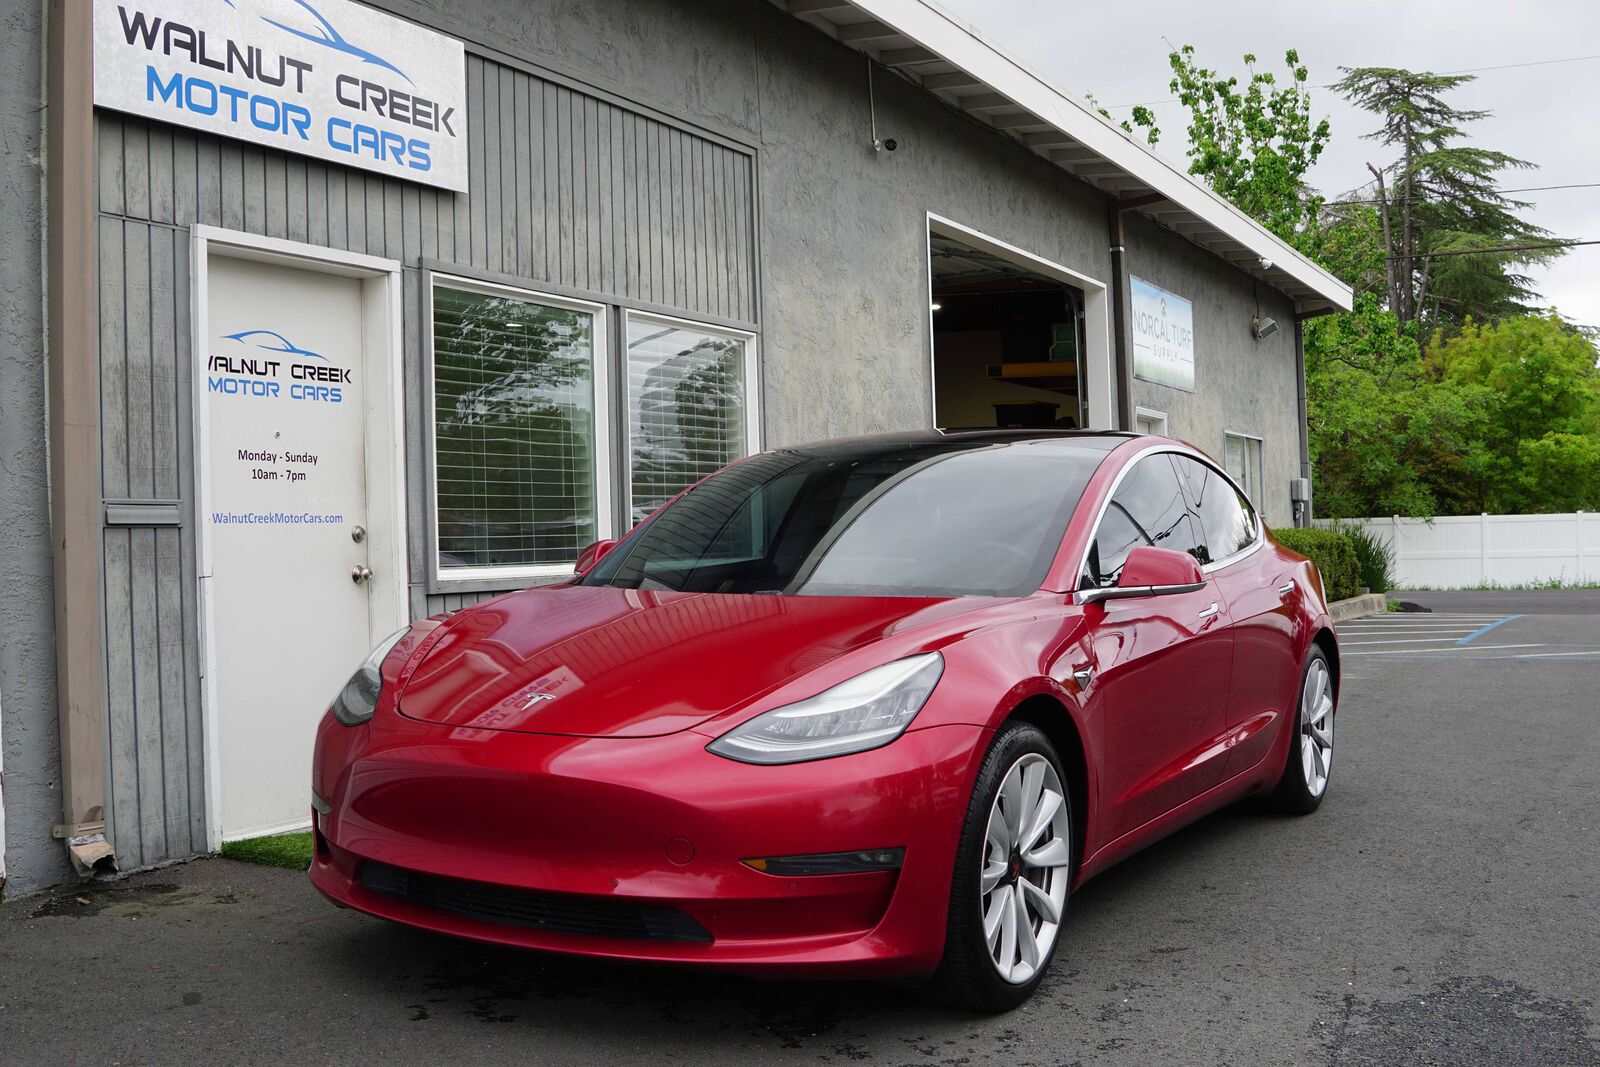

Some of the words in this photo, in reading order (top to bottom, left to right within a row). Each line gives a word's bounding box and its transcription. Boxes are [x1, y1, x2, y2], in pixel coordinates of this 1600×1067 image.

[118, 5, 313, 94] WALNUT
[335, 73, 457, 138] CREEK
[146, 64, 311, 141] MOTOR
[327, 117, 432, 172] CARS
[208, 355, 280, 377] ALNUT
[291, 364, 352, 384] CREEK
[208, 376, 280, 397] MOTOR
[290, 384, 343, 402] CARS
[238, 449, 277, 464] Monday
[285, 451, 318, 466] Sunday
[251, 468, 278, 480] 10am
[286, 469, 306, 483] 7pm
[212, 512, 344, 524] WalnutCreekMotorCars.com
